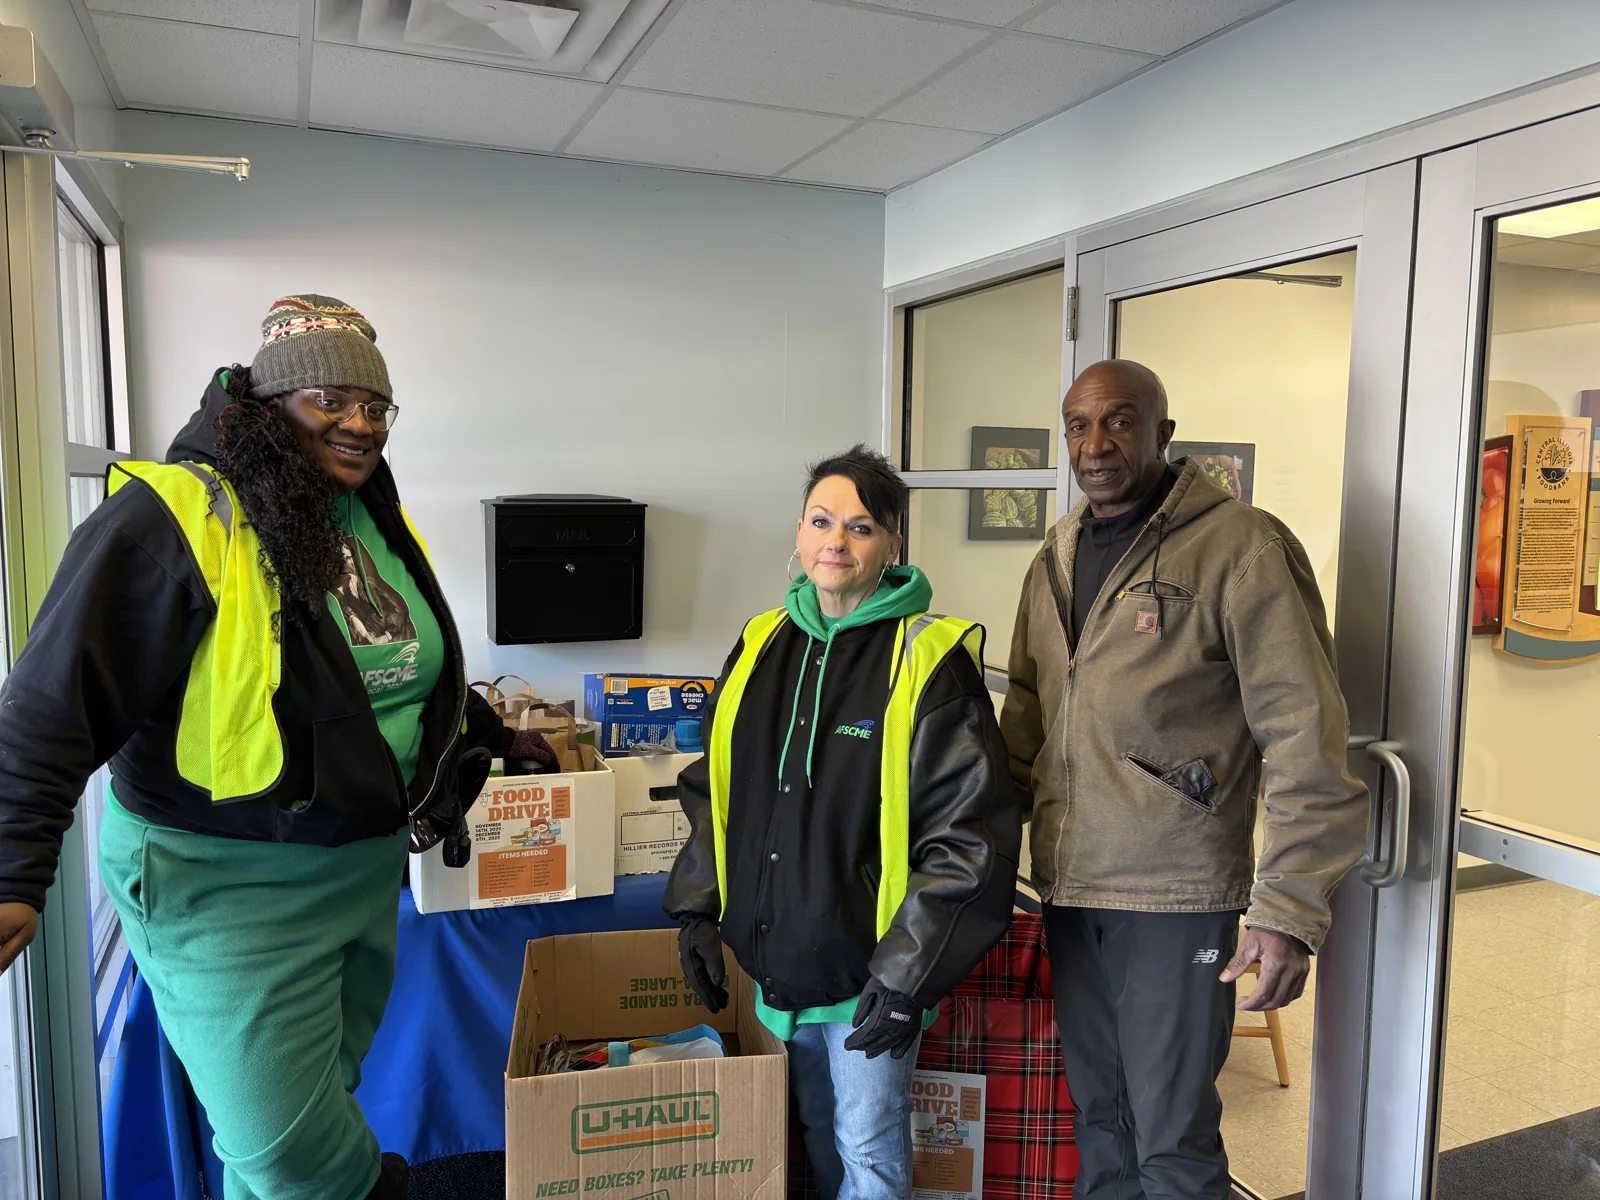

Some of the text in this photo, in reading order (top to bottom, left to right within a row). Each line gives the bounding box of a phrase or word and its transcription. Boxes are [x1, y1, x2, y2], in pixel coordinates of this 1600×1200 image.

[1536, 437, 1573, 465] CENTRAL ILLINOIS
[1537, 475, 1570, 491] FOODBANK
[360, 663, 419, 686] FSCME
[367, 684, 384, 695] ocal
[834, 725, 872, 739] AFSCME
[492, 787, 545, 805] FOOD
[488, 803, 550, 822] DRIVE
[498, 849, 549, 859] ITEMS NEEDED
[623, 844, 648, 852] HILLIER
[619, 993, 678, 1010] GRANDE
[911, 1080, 954, 1098] OOD
[911, 1098, 958, 1116] RIVE
[582, 1099, 711, 1134] U-HAUL
[925, 1147, 955, 1155] NEEDED
[535, 1158, 755, 1198] NEED BOXES? TAKE PLENTY!
